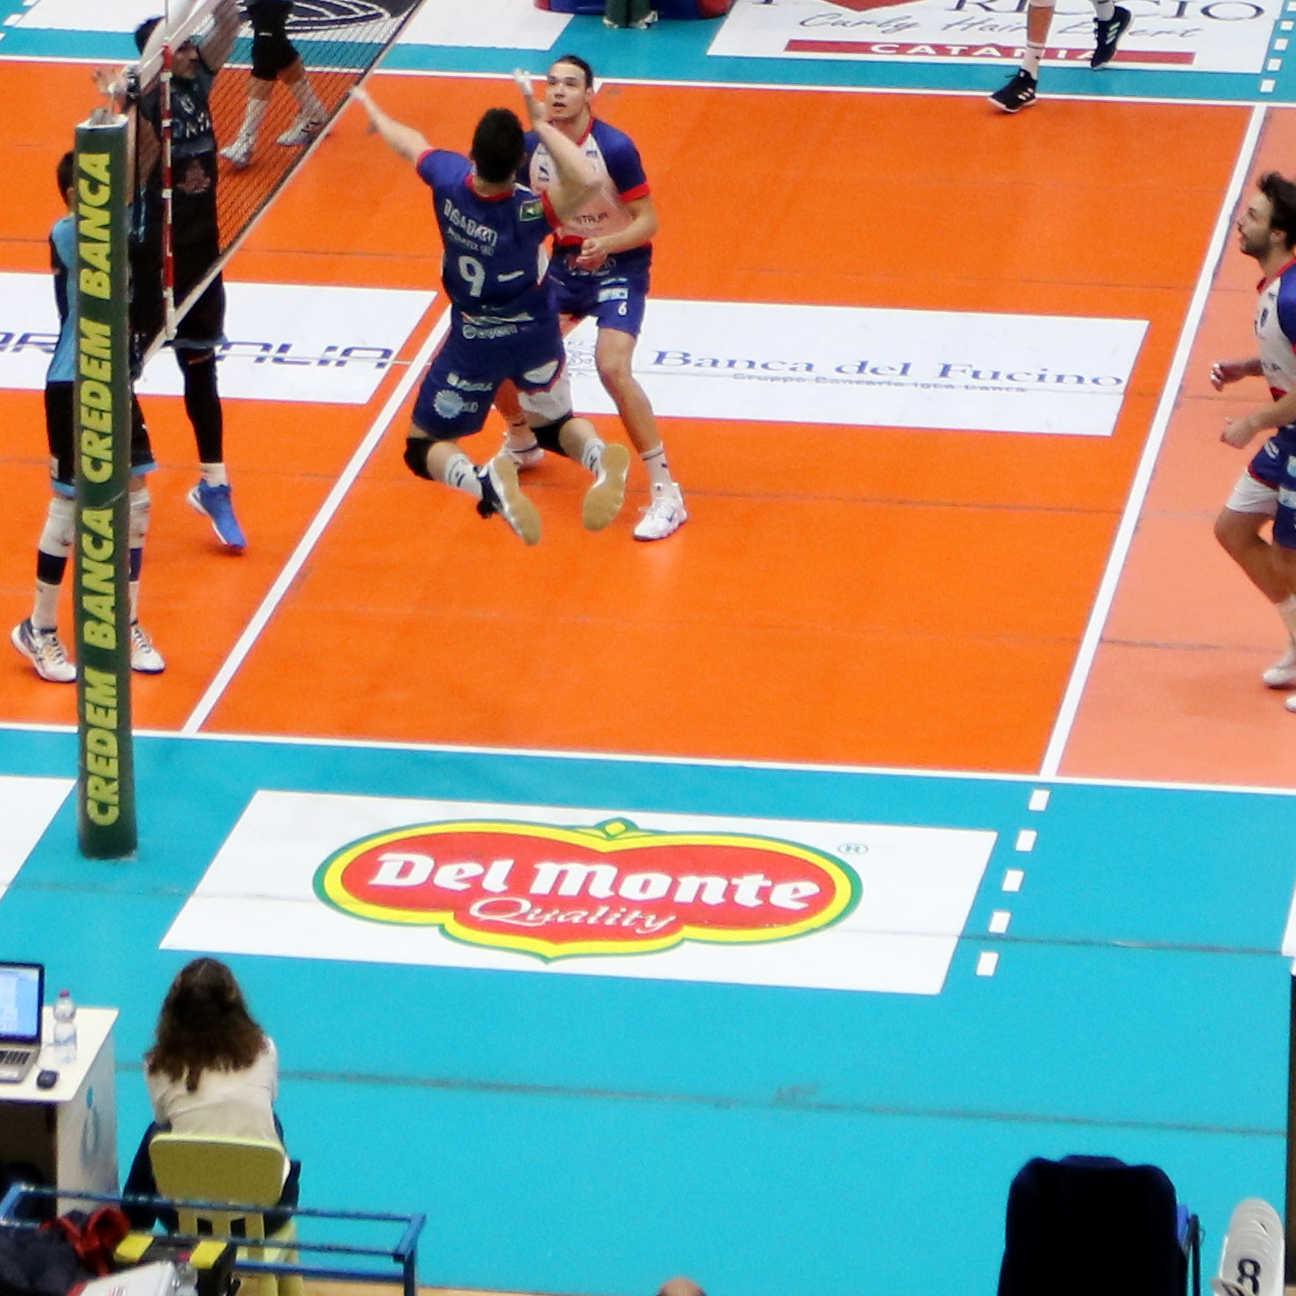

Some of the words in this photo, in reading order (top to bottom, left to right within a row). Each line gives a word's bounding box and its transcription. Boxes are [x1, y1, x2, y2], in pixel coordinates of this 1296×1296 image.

[80, 152, 112, 302] BANCA
[458, 255, 487, 299] 9
[617, 301, 628, 316] 6
[652, 348, 814, 375] Banca
[834, 350, 912, 379] del
[936, 362, 1125, 388] Fucino
[80, 318, 114, 484] CREDEM
[83, 507, 115, 655] BANCA
[85, 670, 117, 828] CREDEM
[369, 852, 508, 894] Del
[529, 860, 822, 910] Monte
[468, 895, 678, 935] Quality
